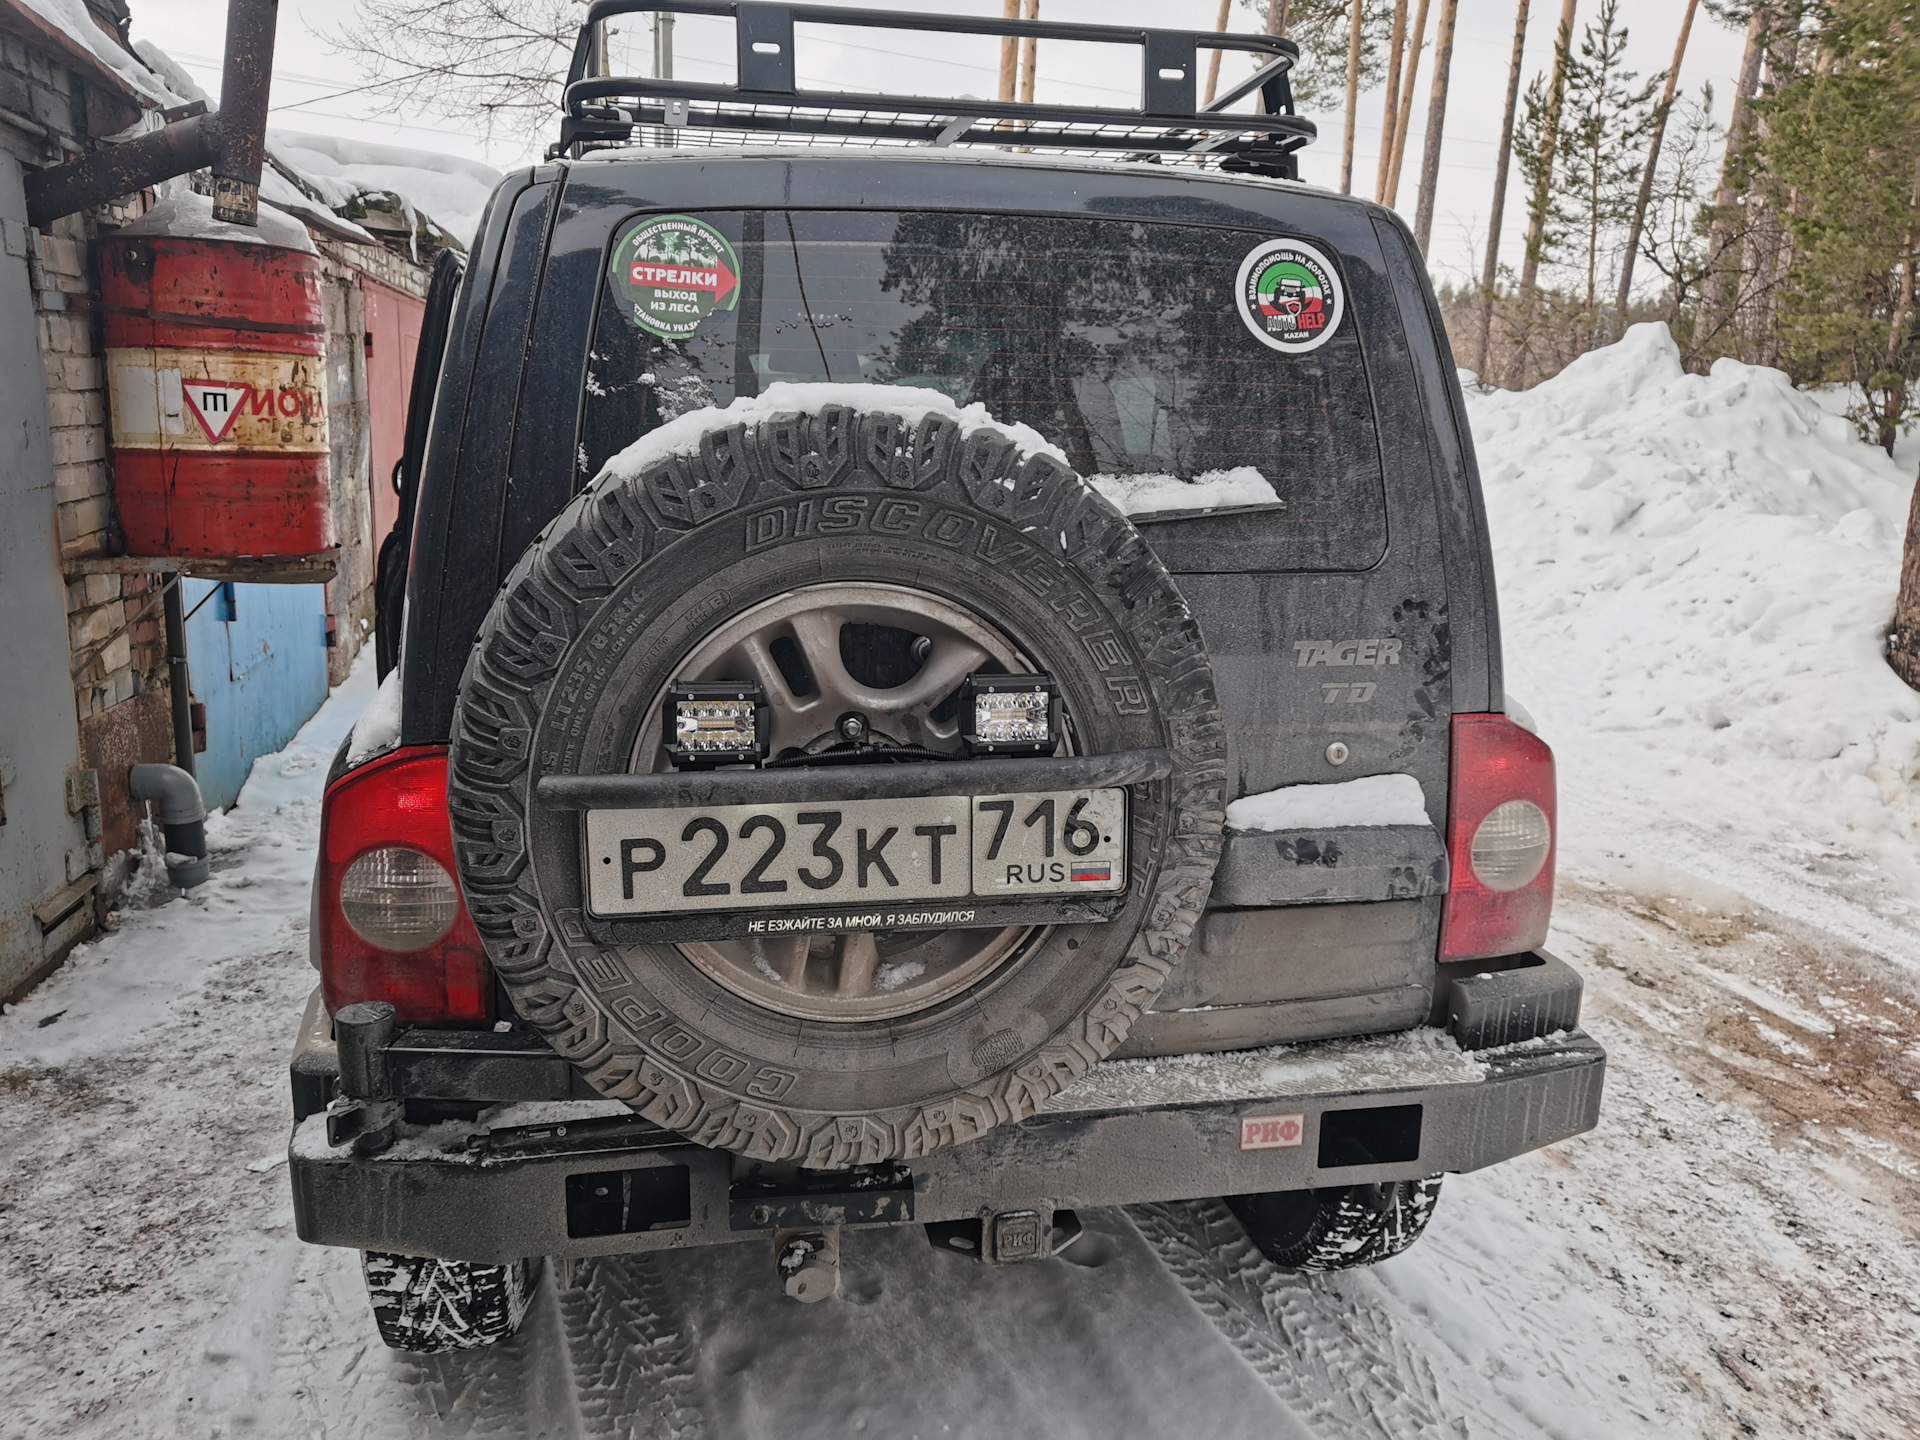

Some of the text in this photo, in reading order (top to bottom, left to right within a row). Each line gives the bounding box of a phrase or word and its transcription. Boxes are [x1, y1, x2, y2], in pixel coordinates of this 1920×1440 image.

[632, 222, 725, 254] ОБЩЕСТВЕННЫЙ ПРОЕКТ
[632, 266, 718, 287] СТРЕЛКИ
[1248, 251, 1332, 300] ВЗАИМОПОМОЩЬ НА ДОРОГАХ
[650, 300, 700, 314] ИЗ ЛЕСА
[654, 289, 697, 302] ВЫХОД
[633, 302, 672, 332] СТАНОВКА
[1297, 313, 1325, 329] HELP
[1284, 331, 1309, 339] KAZAN
[744, 495, 1150, 717] DISCOVERER
[1292, 638, 1402, 668] TAGER
[561, 741, 576, 775] OUNT
[625, 612, 647, 635] RIM
[1320, 681, 1378, 704] TD
[978, 796, 1100, 861] 716
[1005, 861, 1066, 886] RUS
[748, 920, 766, 933] НЕ
[767, 915, 826, 932] ЕЗЖАЙТЕ
[826, 916, 844, 929] ЗА
[886, 914, 897, 926] Я
[896, 910, 976, 926] ЗАБЛУДИЛСЯ
[1244, 1120, 1301, 1145] РИФ
